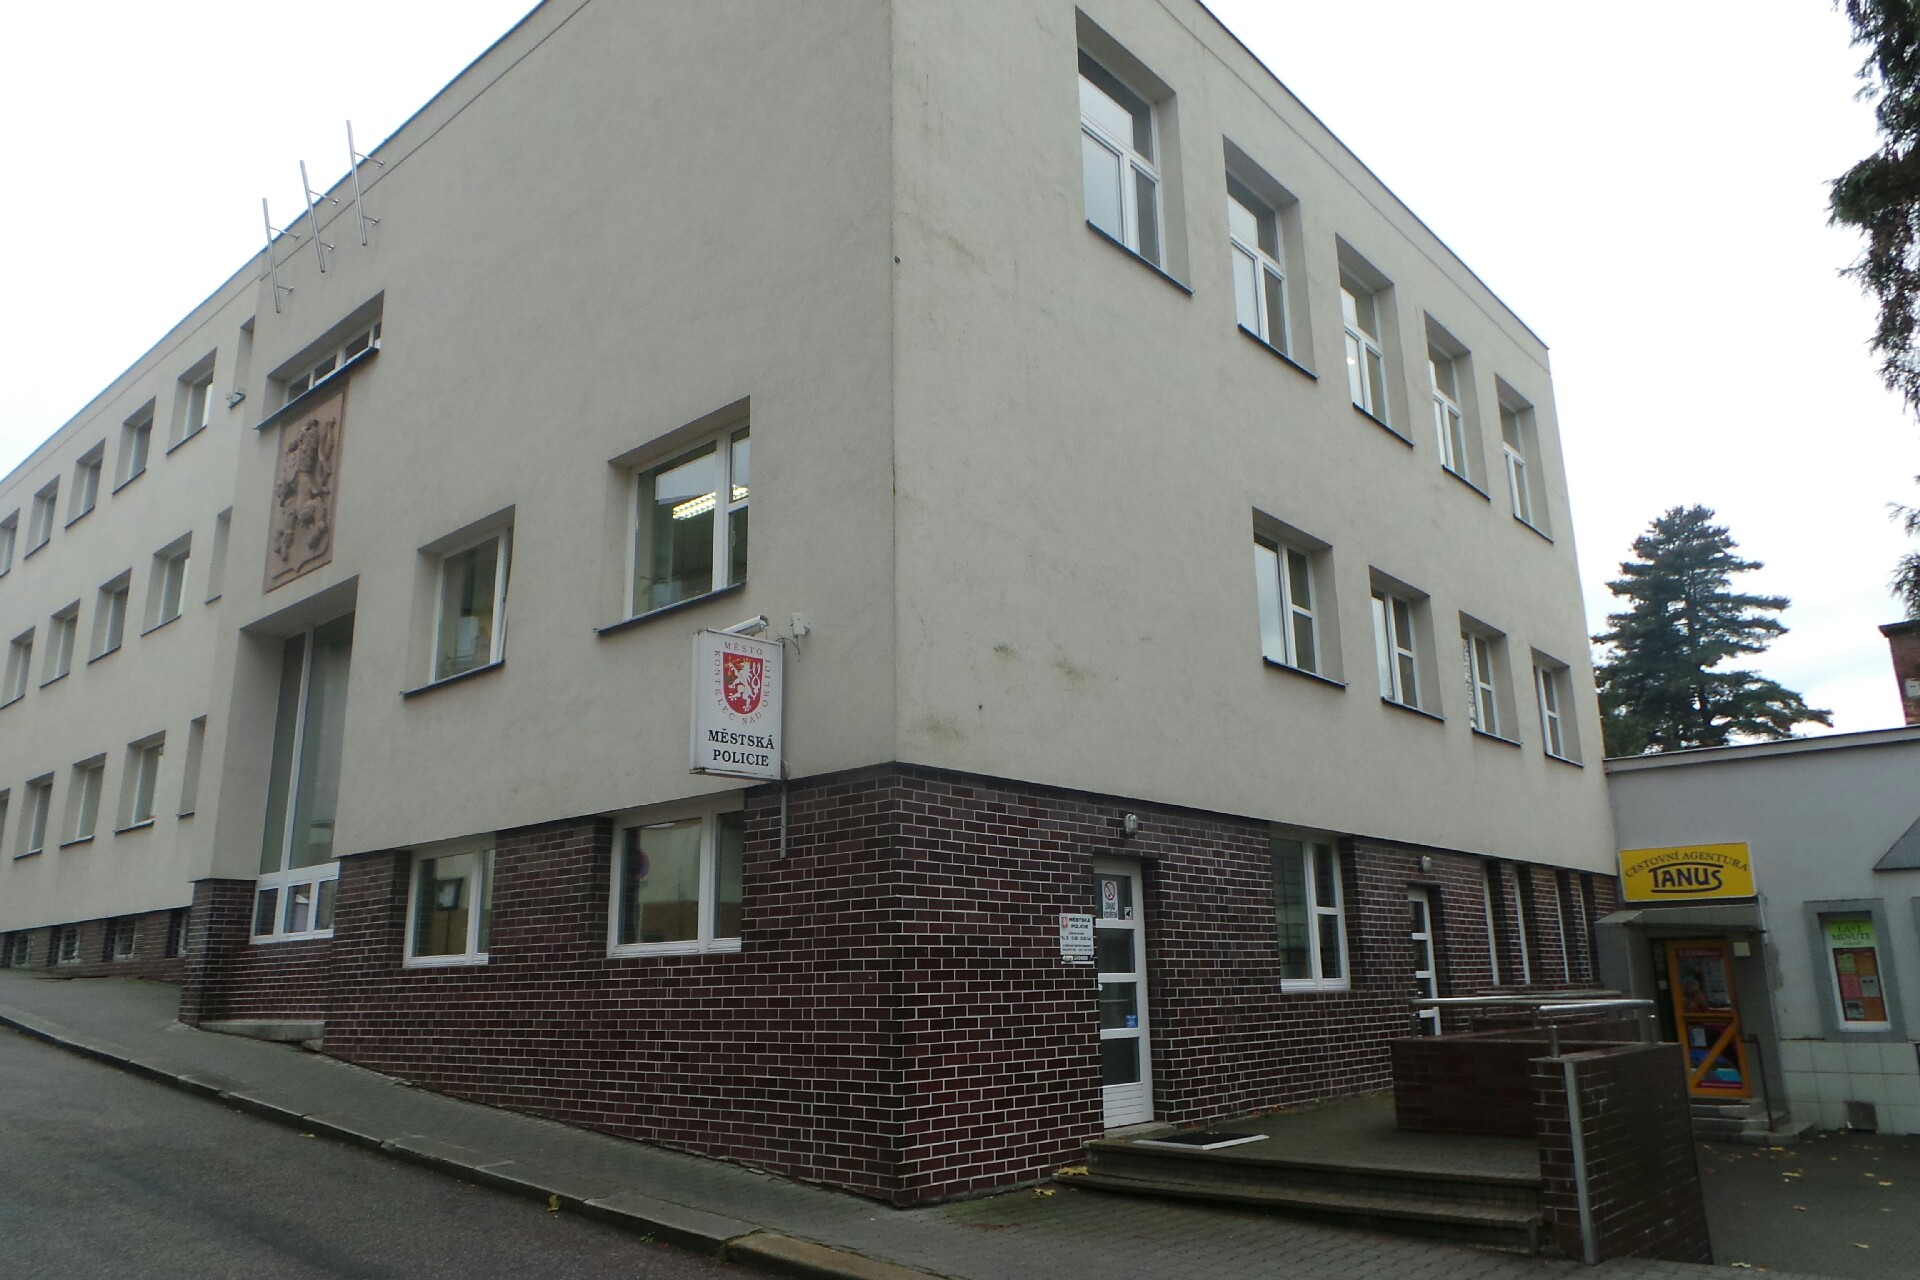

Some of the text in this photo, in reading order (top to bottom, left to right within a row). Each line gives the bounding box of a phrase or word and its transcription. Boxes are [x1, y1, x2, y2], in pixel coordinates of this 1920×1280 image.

[724, 641, 763, 656] MĚSTO
[742, 711, 762, 725] NAD
[708, 728, 775, 750] MĚSTSKÁ
[712, 749, 769, 767] POLICIE
[1625, 849, 1748, 878] CESTOVNÍ AGENTURA
[1648, 861, 1724, 893] TANUS
